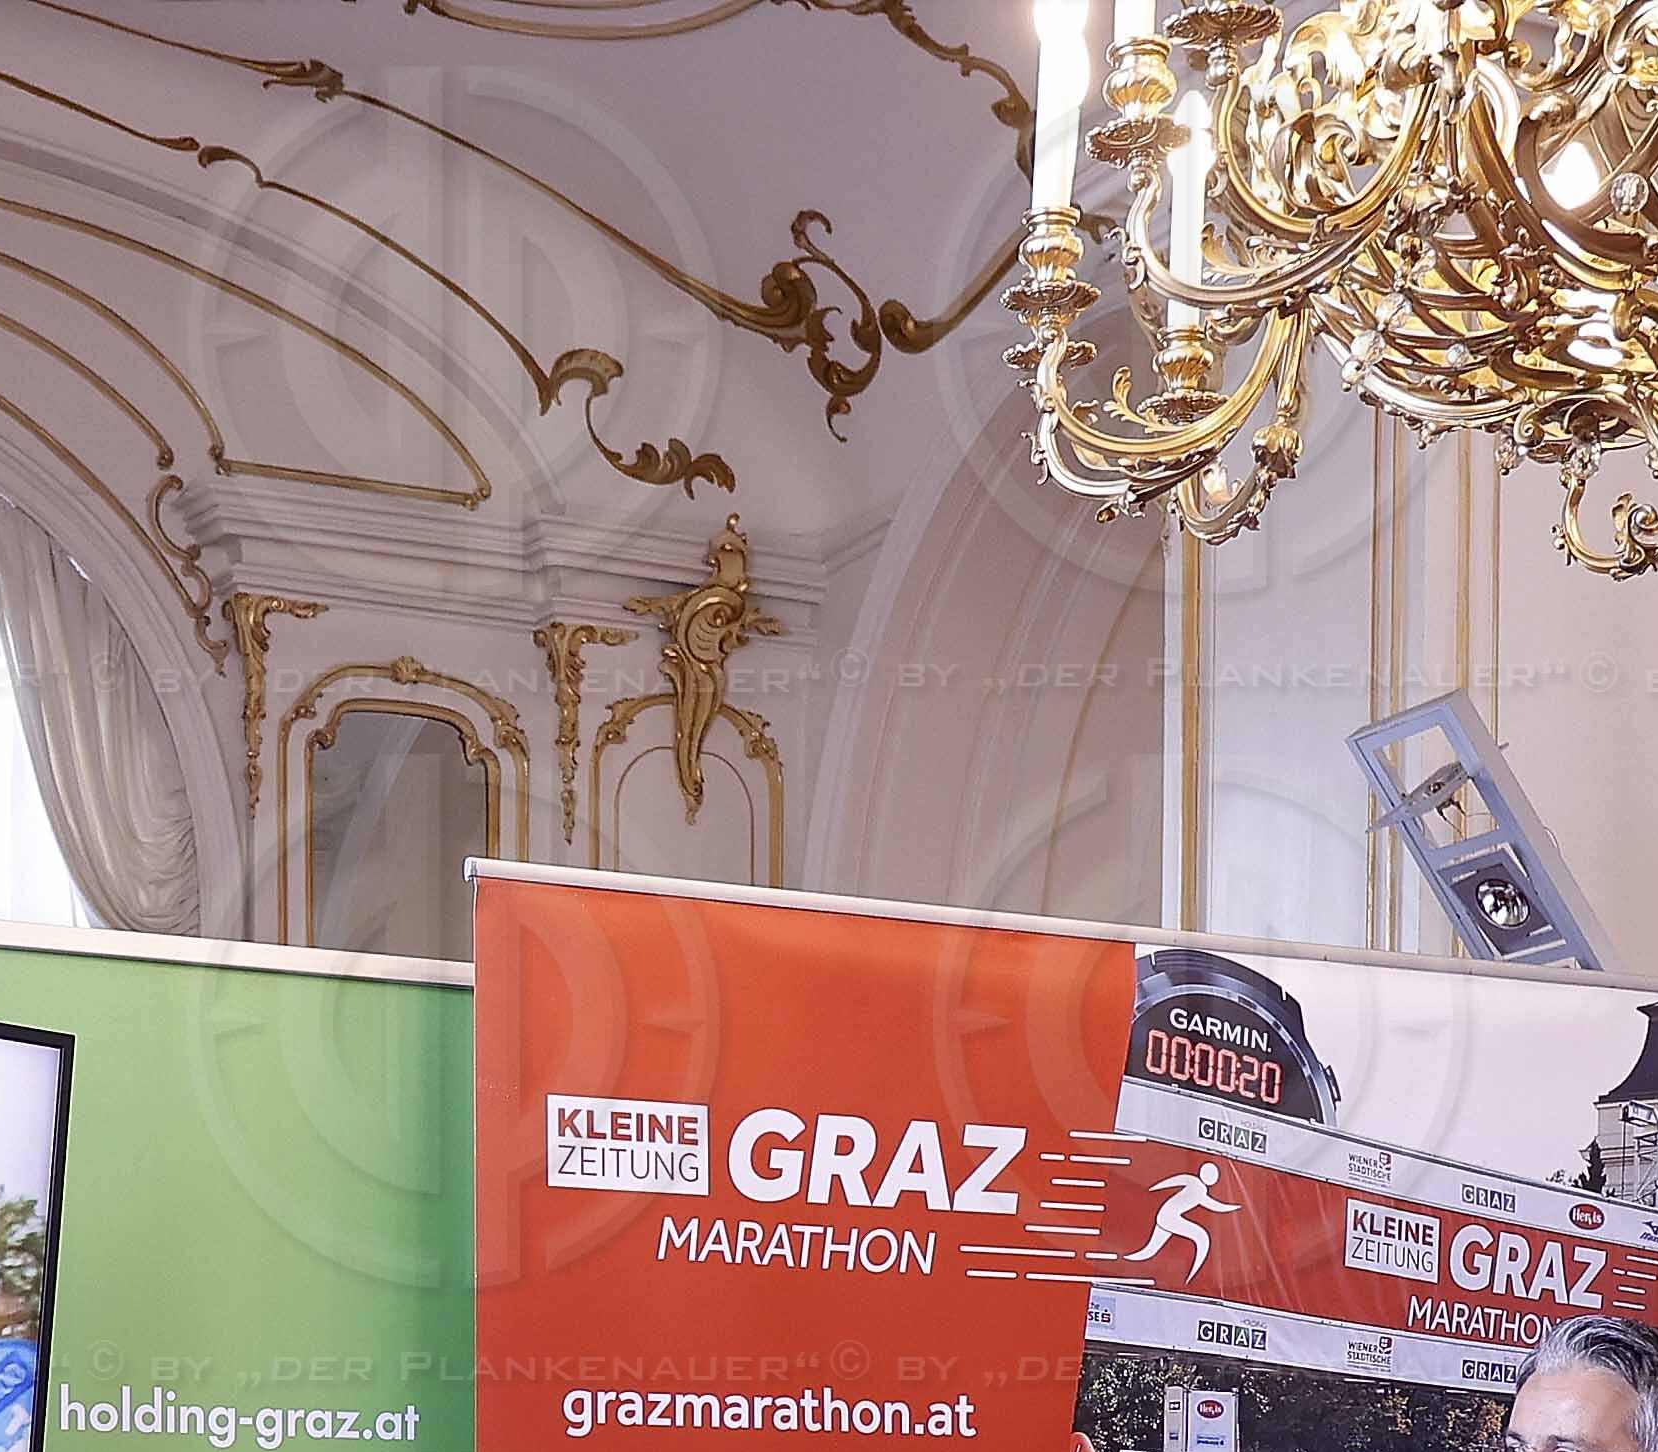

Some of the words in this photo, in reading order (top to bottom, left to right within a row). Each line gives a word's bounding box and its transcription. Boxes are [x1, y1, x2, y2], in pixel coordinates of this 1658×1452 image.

[1199, 1117, 1267, 1153] GRAZ
[558, 1109, 699, 1145] KLEINE
[727, 1108, 1027, 1214] GRAZ
[558, 1145, 699, 1183] ZEITUNG
[1348, 1153, 1378, 1167] WIENER
[1462, 1184, 1515, 1213] GRAZ
[658, 1217, 935, 1275] MARATHON
[1351, 1237, 1433, 1275] ZEITUNG
[1353, 1209, 1435, 1247] KLEINE
[1449, 1225, 1608, 1309] GRAZ
[1198, 1320, 1268, 1351] GRAZ
[1348, 1341, 1378, 1353] WIENER
[1462, 1359, 1517, 1384] GRAZ
[59, 1383, 420, 1450] holding-graz.at
[562, 1387, 978, 1438] grazmarathon.at
